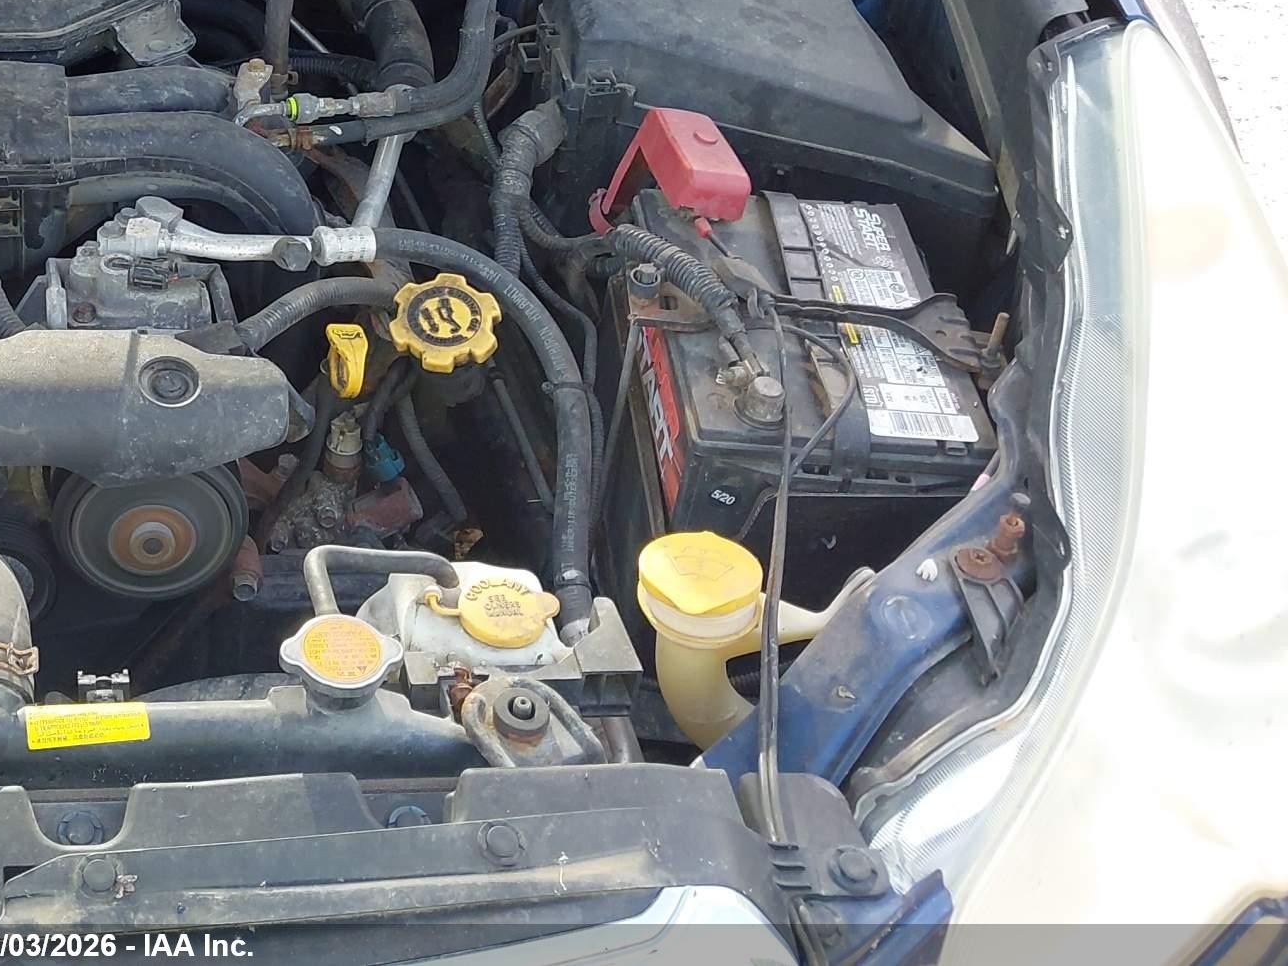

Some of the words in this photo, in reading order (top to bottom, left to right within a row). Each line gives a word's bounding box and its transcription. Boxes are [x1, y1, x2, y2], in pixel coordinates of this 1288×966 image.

[852, 207, 881, 253] START
[868, 213, 892, 252] SUPER
[637, 326, 675, 465] TART
[711, 489, 736, 505] 5/20
[465, 578, 531, 601] COOLANT
